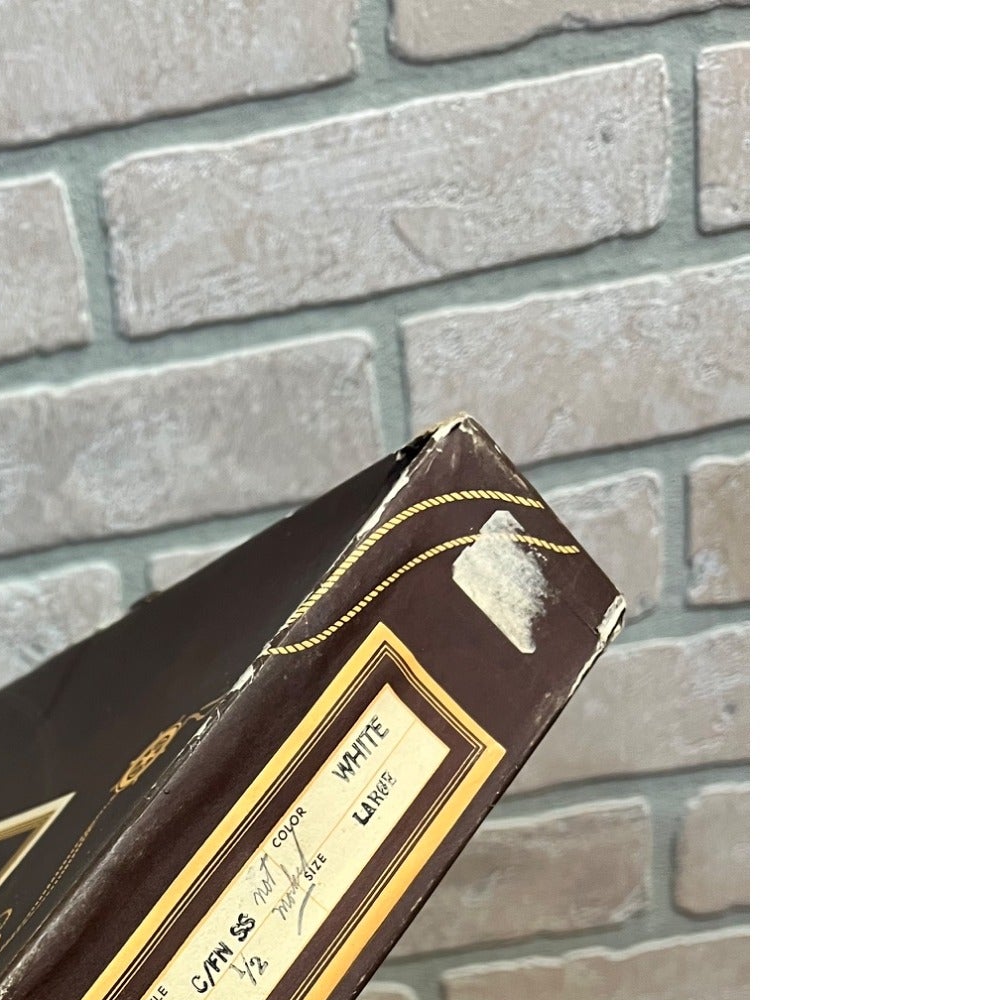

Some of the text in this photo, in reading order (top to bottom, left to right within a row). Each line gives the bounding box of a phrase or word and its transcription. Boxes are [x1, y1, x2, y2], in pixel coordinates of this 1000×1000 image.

[272, 714, 390, 848] COLOR WHITE
[303, 769, 397, 881] SIZE LARGE
[230, 913, 256, 942] SS
